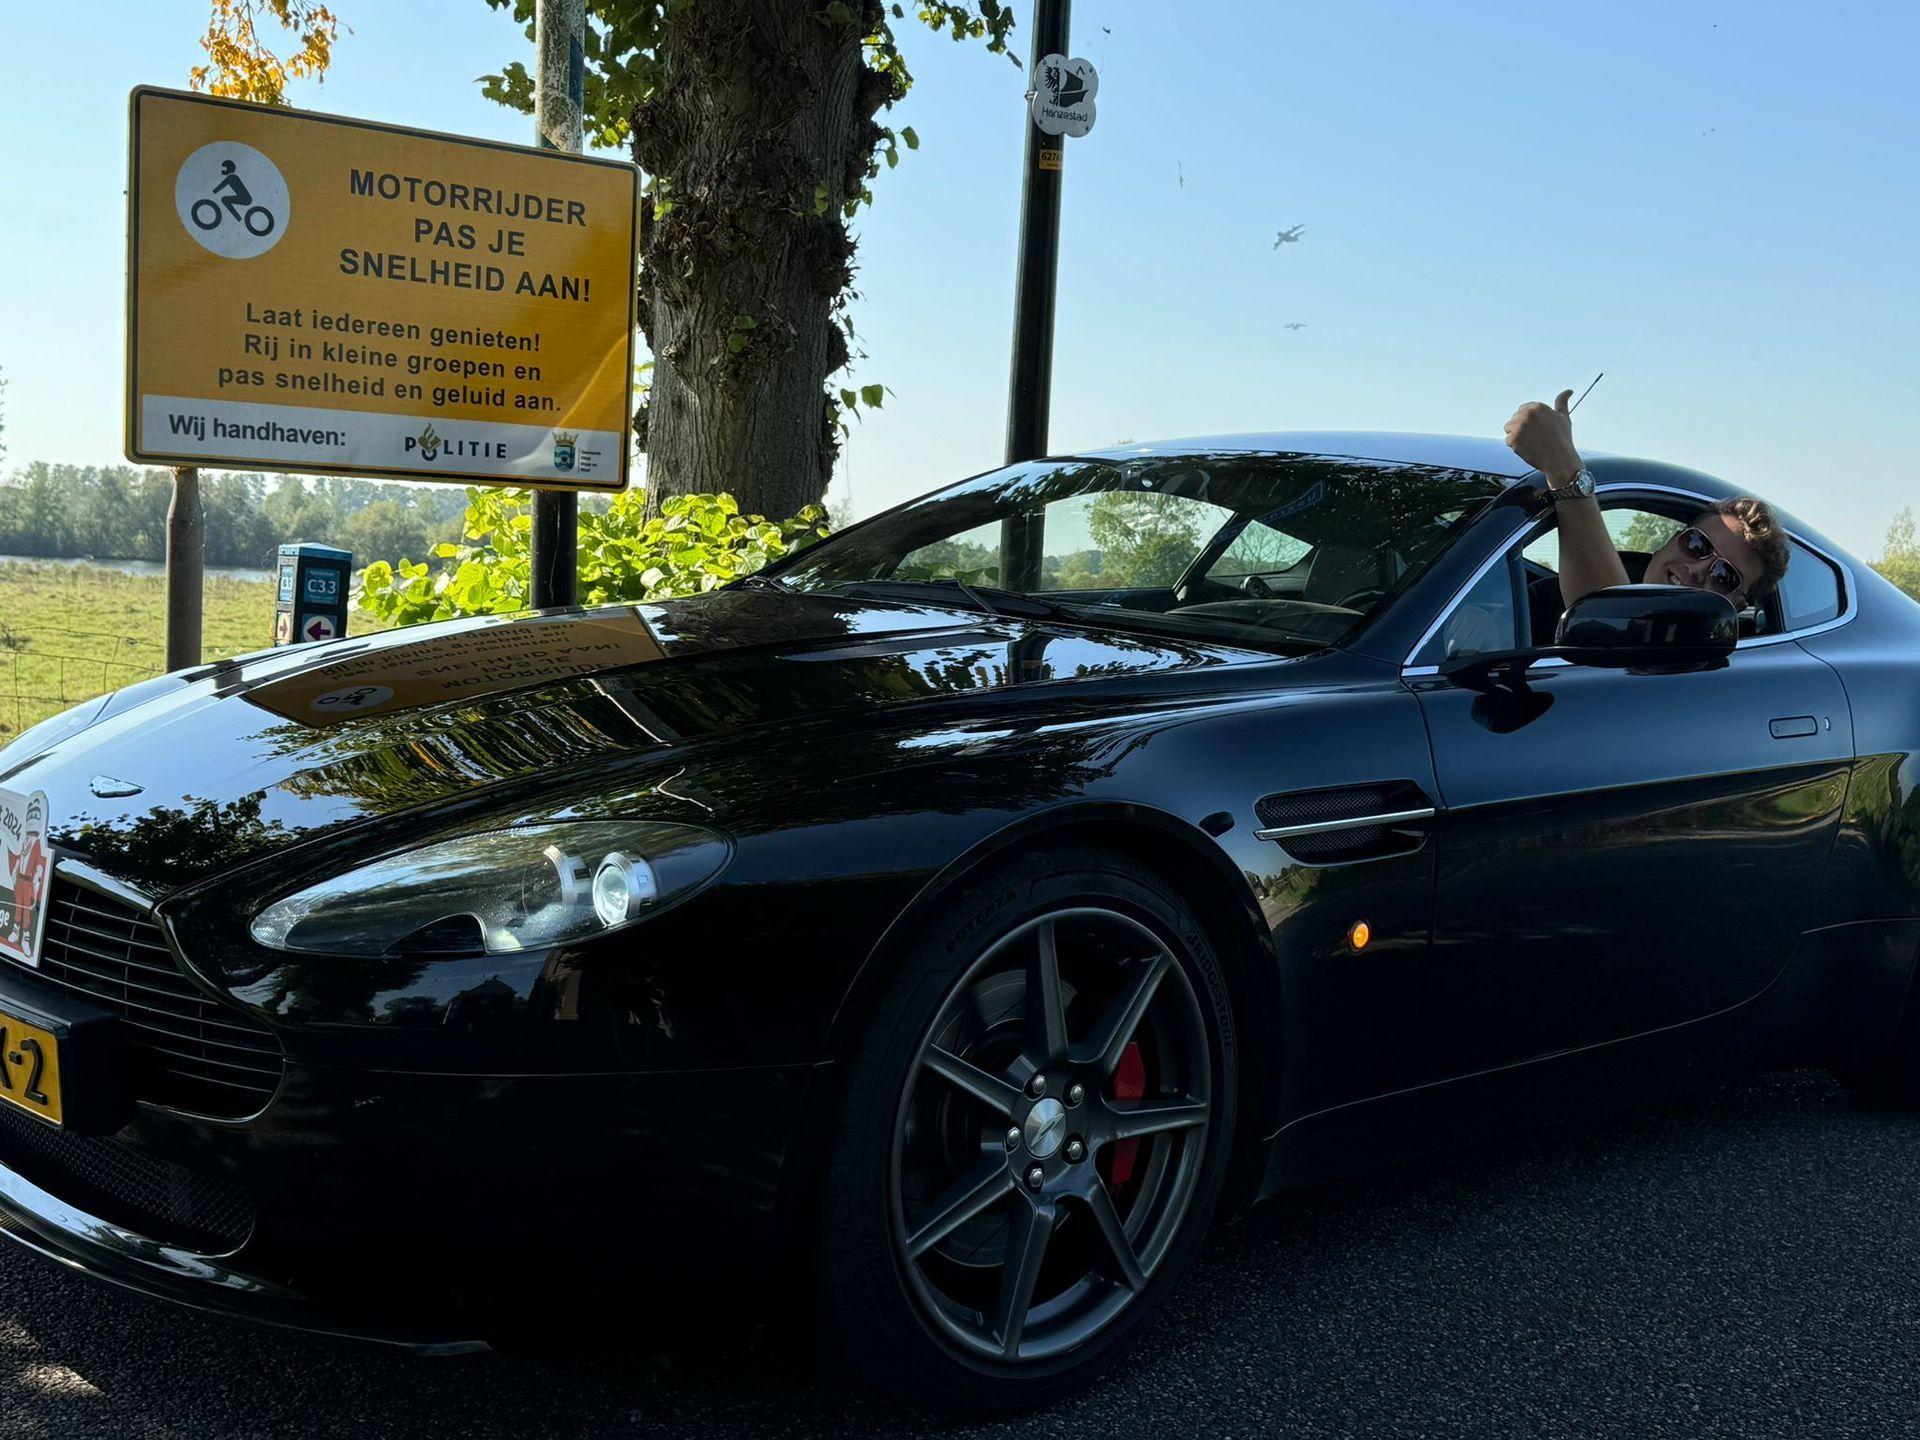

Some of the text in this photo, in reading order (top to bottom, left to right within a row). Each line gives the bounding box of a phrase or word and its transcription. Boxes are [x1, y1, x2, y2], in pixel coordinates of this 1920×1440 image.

[1042, 106, 1088, 122] Hanzestad
[351, 169, 586, 227] MOTORRIJDER
[415, 218, 524, 256] PAS JE
[340, 249, 589, 302] SNELHEID AAN!
[247, 303, 539, 352] Laat iedereen genieten!
[245, 334, 540, 381] Rij in kleine groepen en
[219, 368, 561, 411] pas snelheid en geluid aan.
[168, 414, 345, 446] Wij handhaven:
[405, 437, 506, 461] POLITIE
[307, 579, 336, 594] C33
[3, 807, 22, 842] 2024
